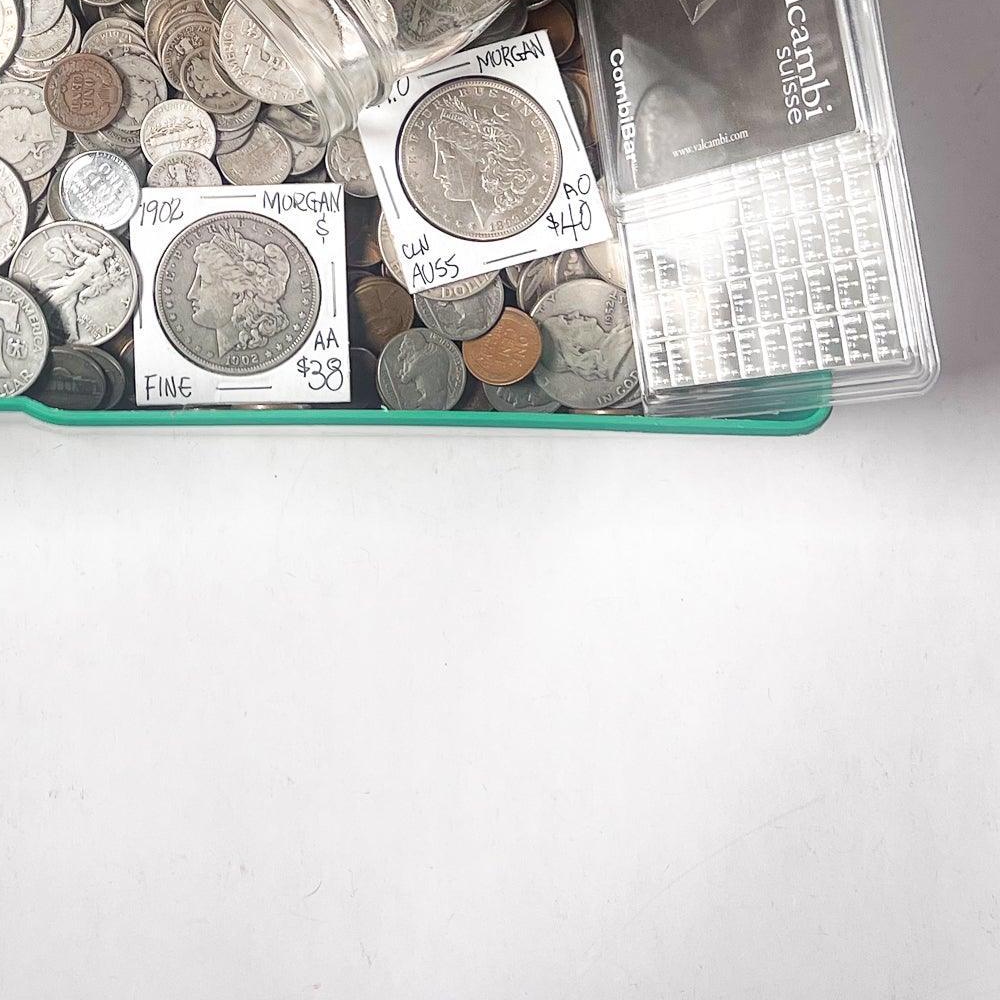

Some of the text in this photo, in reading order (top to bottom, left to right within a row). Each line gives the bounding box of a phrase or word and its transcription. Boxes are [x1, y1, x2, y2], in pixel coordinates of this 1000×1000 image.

[477, 35, 545, 73] MORGAN
[71, 73, 84, 110] CENT
[83, 78, 96, 108] ONE
[776, 46, 802, 125] suisse
[610, 49, 637, 160] CombiBar
[672, 128, 749, 158] www.valcambi.com
[139, 197, 184, 226] 1902
[263, 190, 342, 214] MORGAN
[546, 200, 592, 241] $40
[402, 233, 429, 260] CLN
[441, 273, 490, 299] DOLL
[5, 285, 20, 299] OF
[17, 298, 44, 354] AMERICA
[314, 330, 340, 351] AA
[225, 353, 260, 367] 1902
[297, 355, 344, 392] $38
[145, 374, 192, 401] FINE
